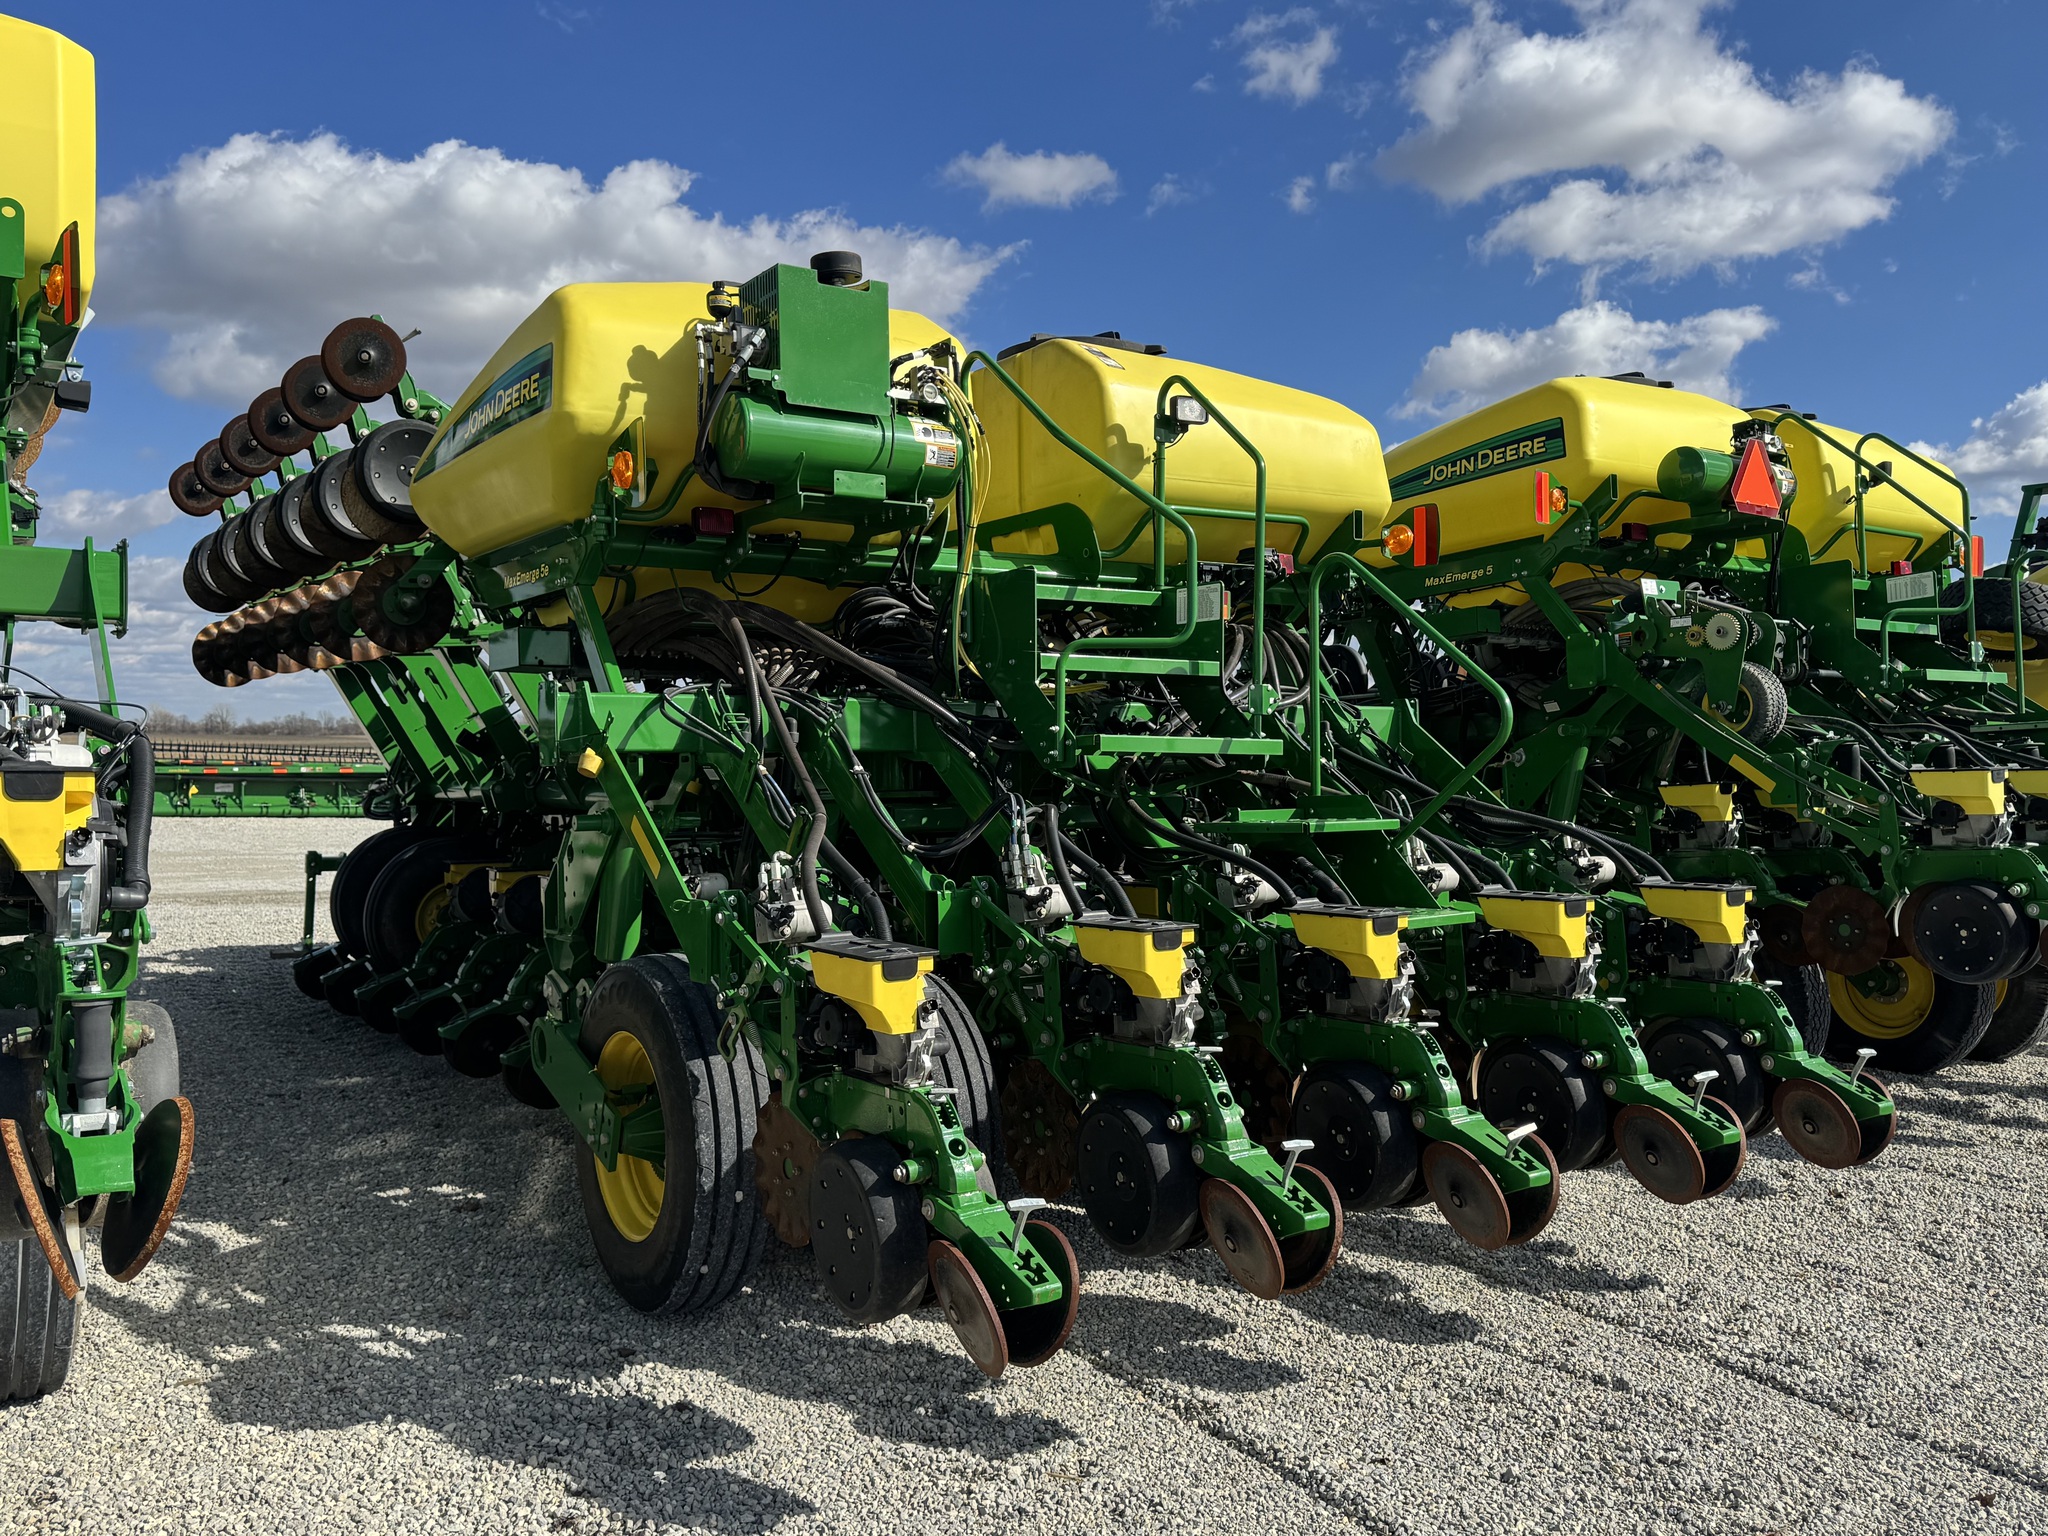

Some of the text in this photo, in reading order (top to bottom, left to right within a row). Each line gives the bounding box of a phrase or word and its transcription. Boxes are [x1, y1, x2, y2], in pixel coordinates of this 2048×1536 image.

[464, 372, 540, 439] JOHN DEERE
[1423, 436, 1547, 486] JOHN DEERE
[504, 563, 549, 589] MaxEmerge 5e
[1424, 564, 1494, 587] MaxEmerge 5
